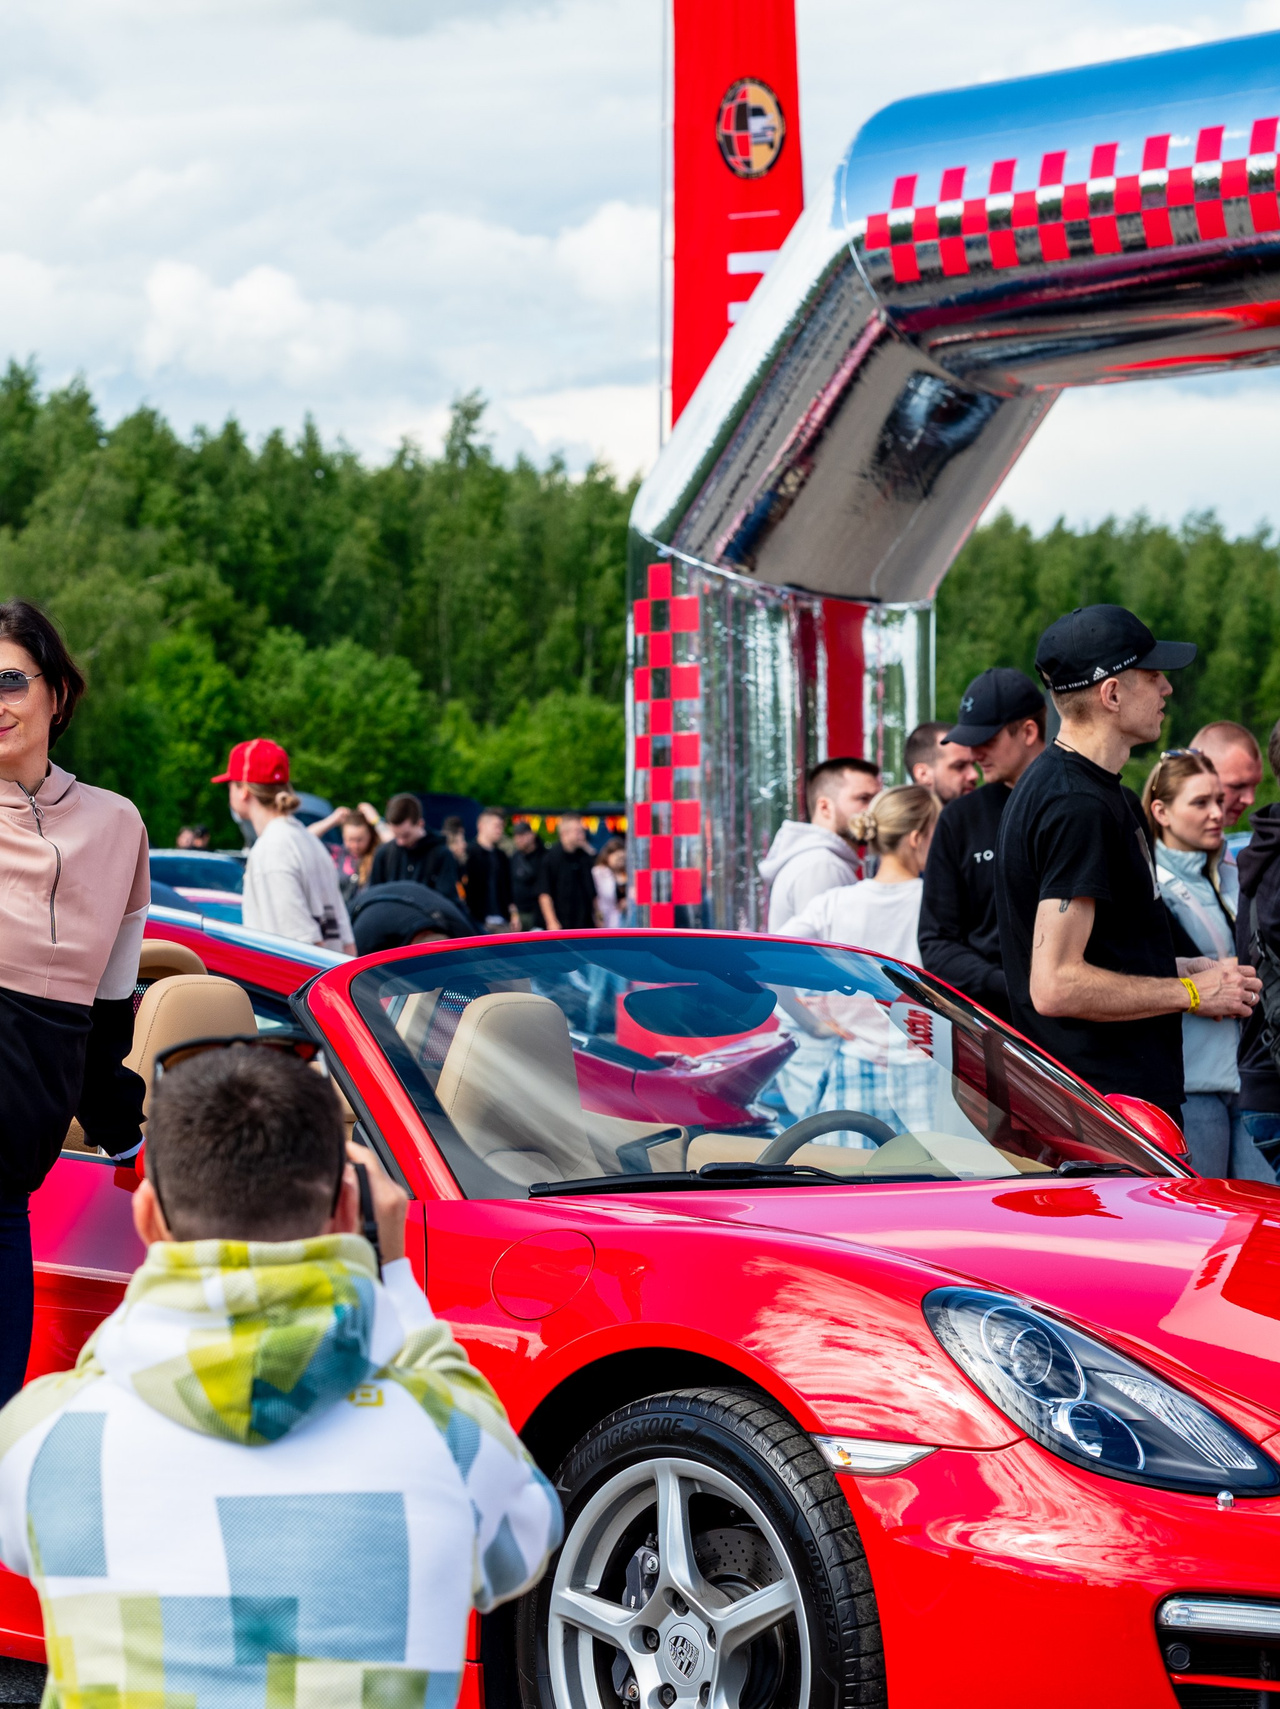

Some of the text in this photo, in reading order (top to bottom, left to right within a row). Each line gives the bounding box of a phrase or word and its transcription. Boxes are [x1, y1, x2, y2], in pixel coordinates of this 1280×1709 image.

[1068, 679, 1089, 689] STRIPES
[570, 1415, 684, 1476] BRIDGESTONE
[804, 1539, 840, 1654] POTENZA
